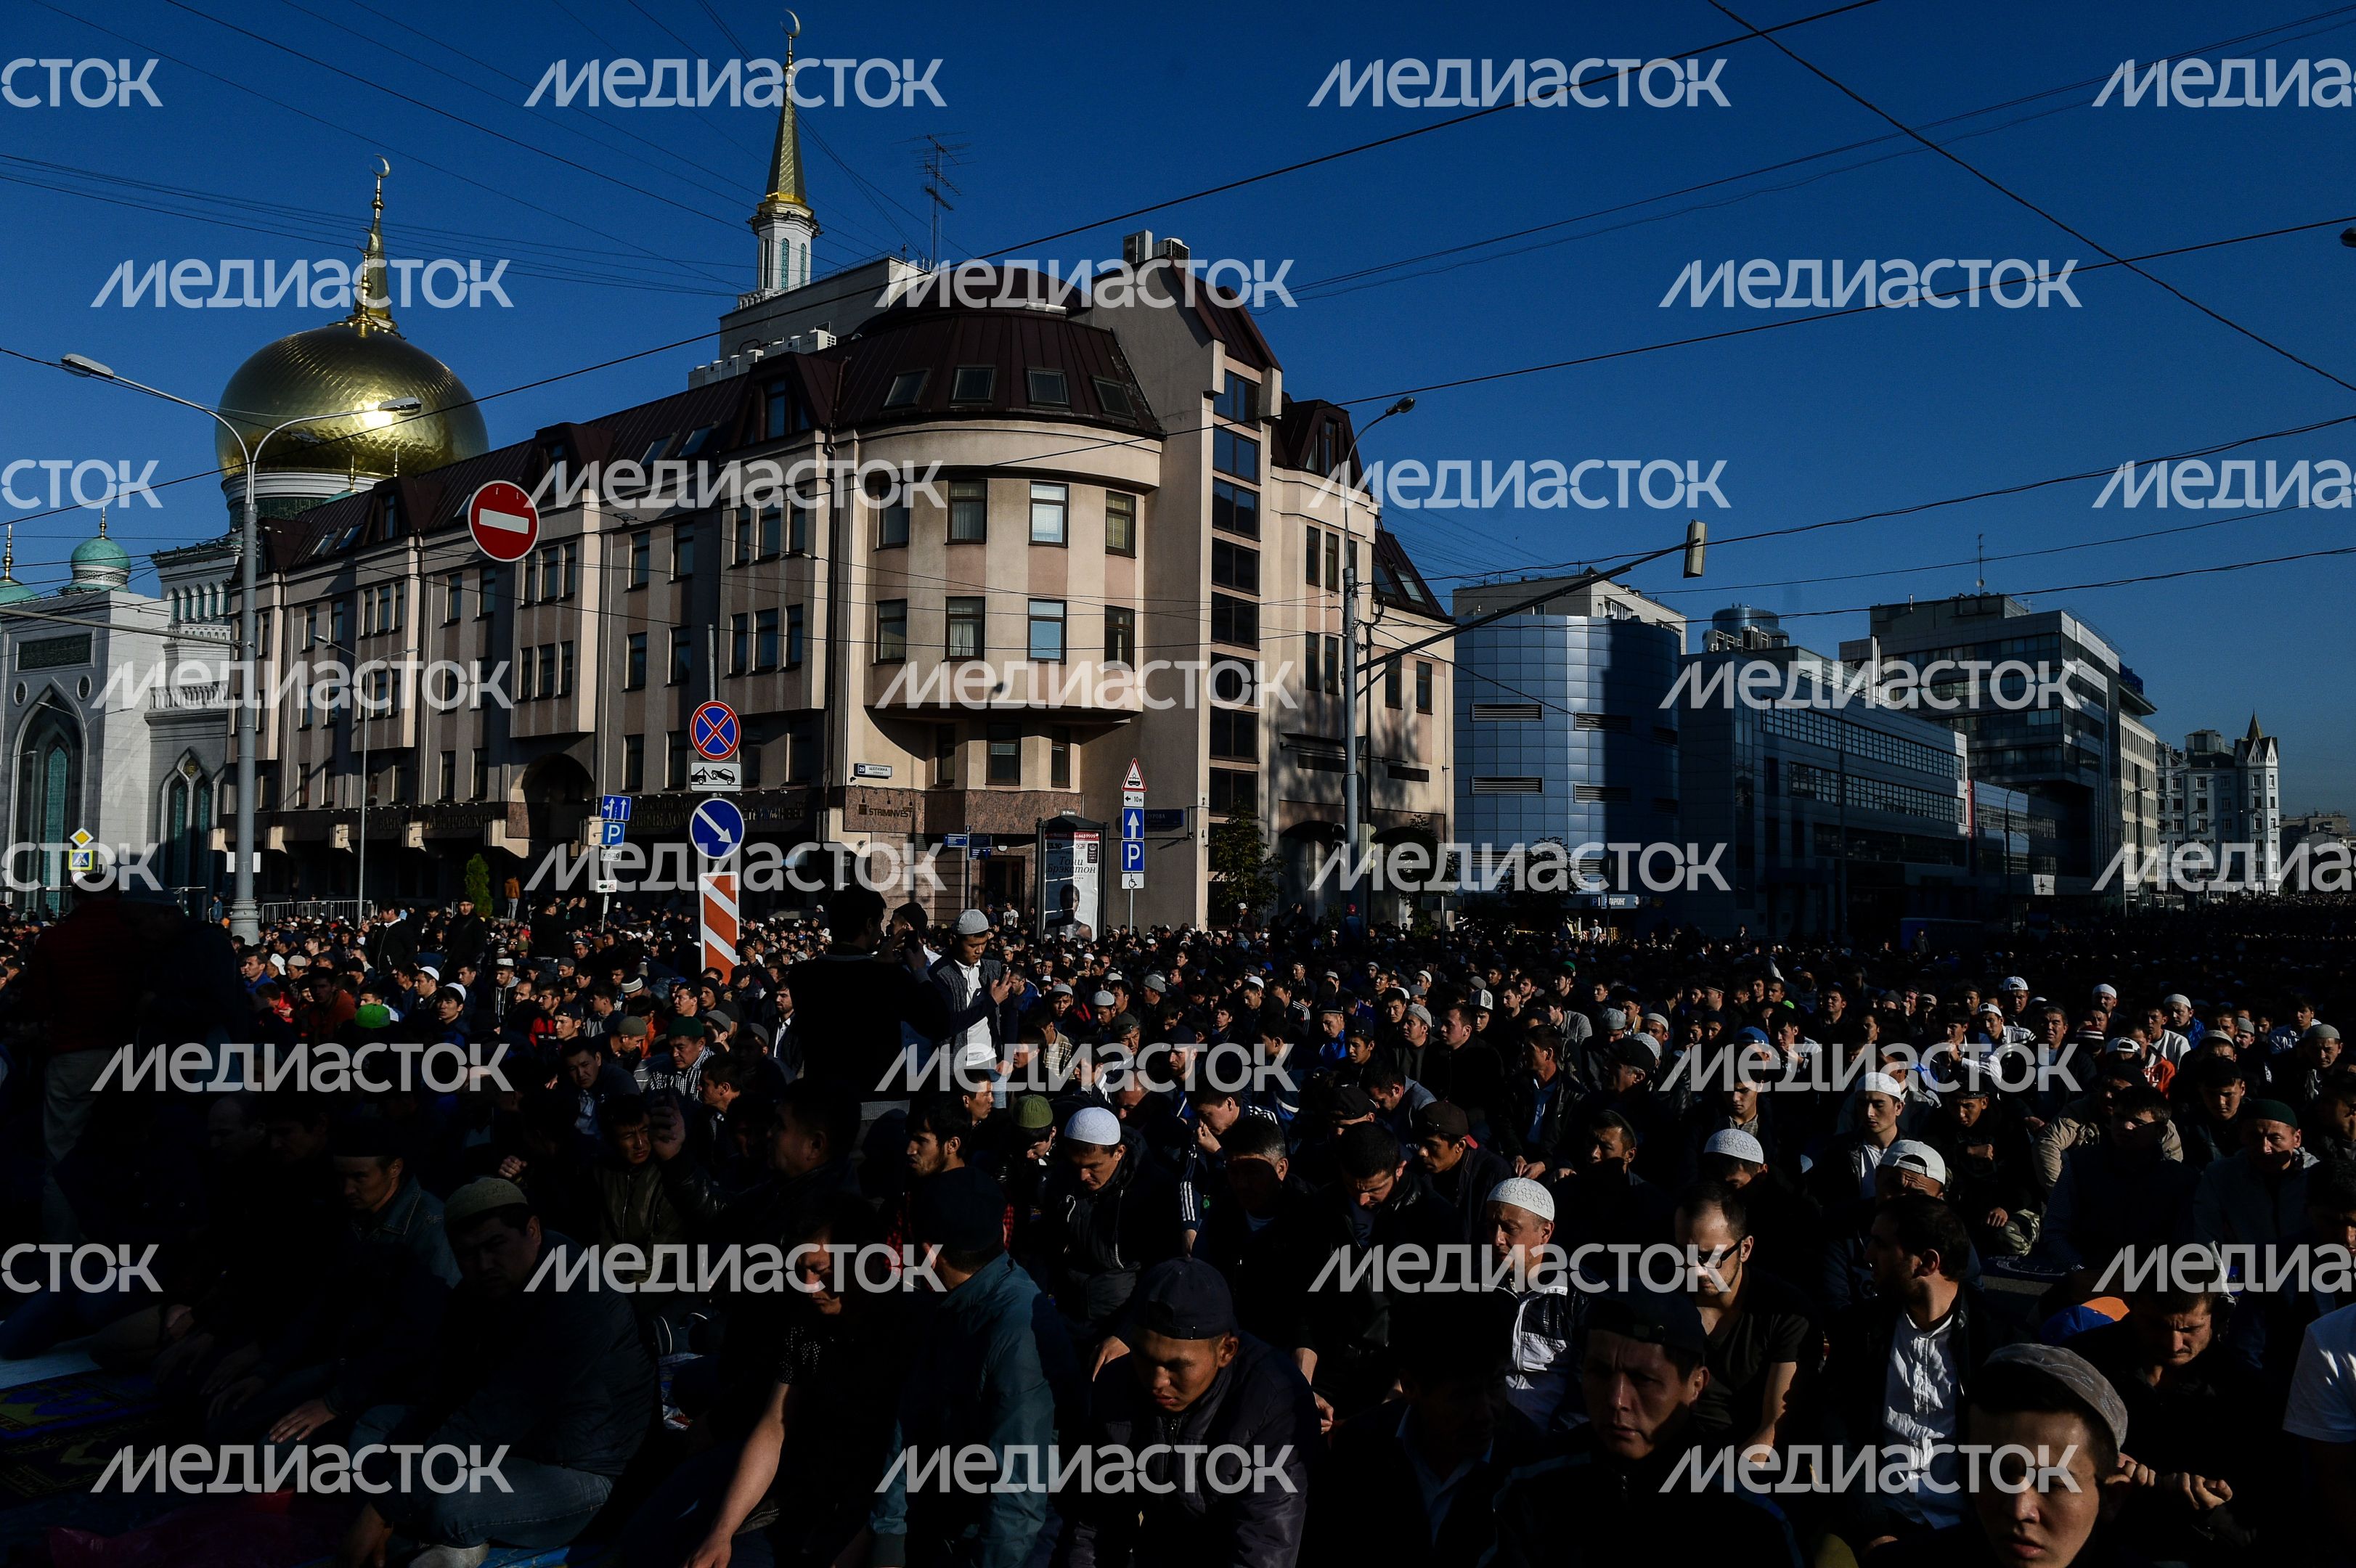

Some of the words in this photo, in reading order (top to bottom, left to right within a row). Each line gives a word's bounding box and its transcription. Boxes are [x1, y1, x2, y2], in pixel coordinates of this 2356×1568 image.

[869, 807, 913, 817] STRIMINVEST
[1059, 856, 1083, 866] Тони
[1047, 863, 1096, 875] Брэкстон
